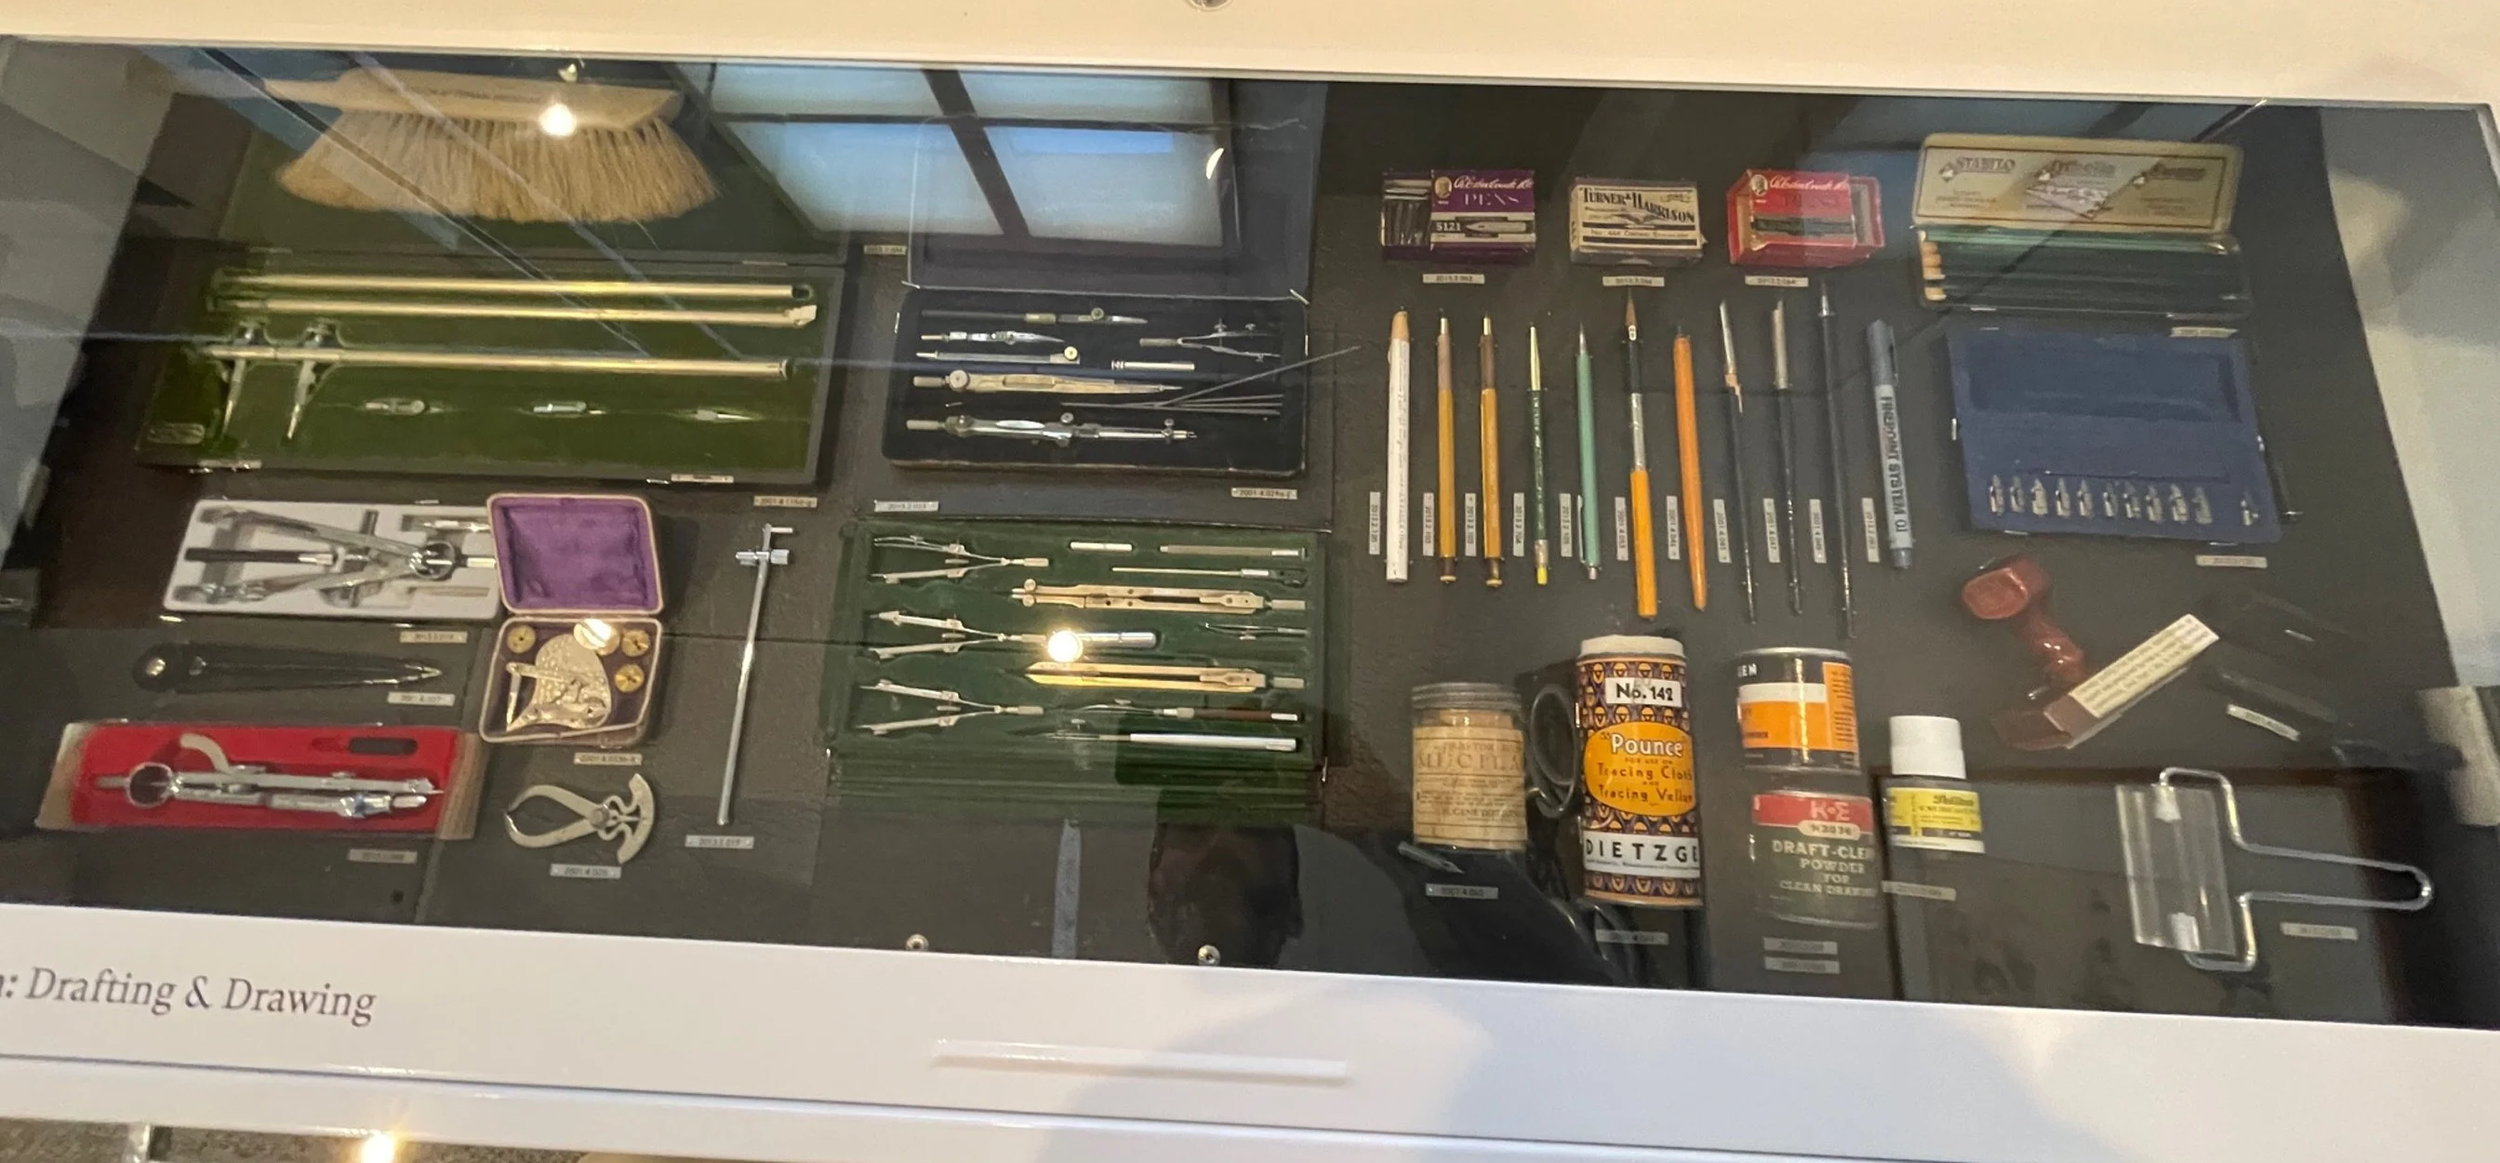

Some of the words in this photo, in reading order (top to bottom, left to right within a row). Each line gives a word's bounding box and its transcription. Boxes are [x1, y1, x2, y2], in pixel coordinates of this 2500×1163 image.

[1616, 683, 1647, 699] No.
[1650, 686, 1673, 701] 142
[1597, 762, 1654, 780] Tracing
[1598, 784, 1648, 803] Tracing
[25, 966, 177, 1016] Drafting
[184, 975, 210, 1010] &
[222, 977, 377, 1028] Drawing
